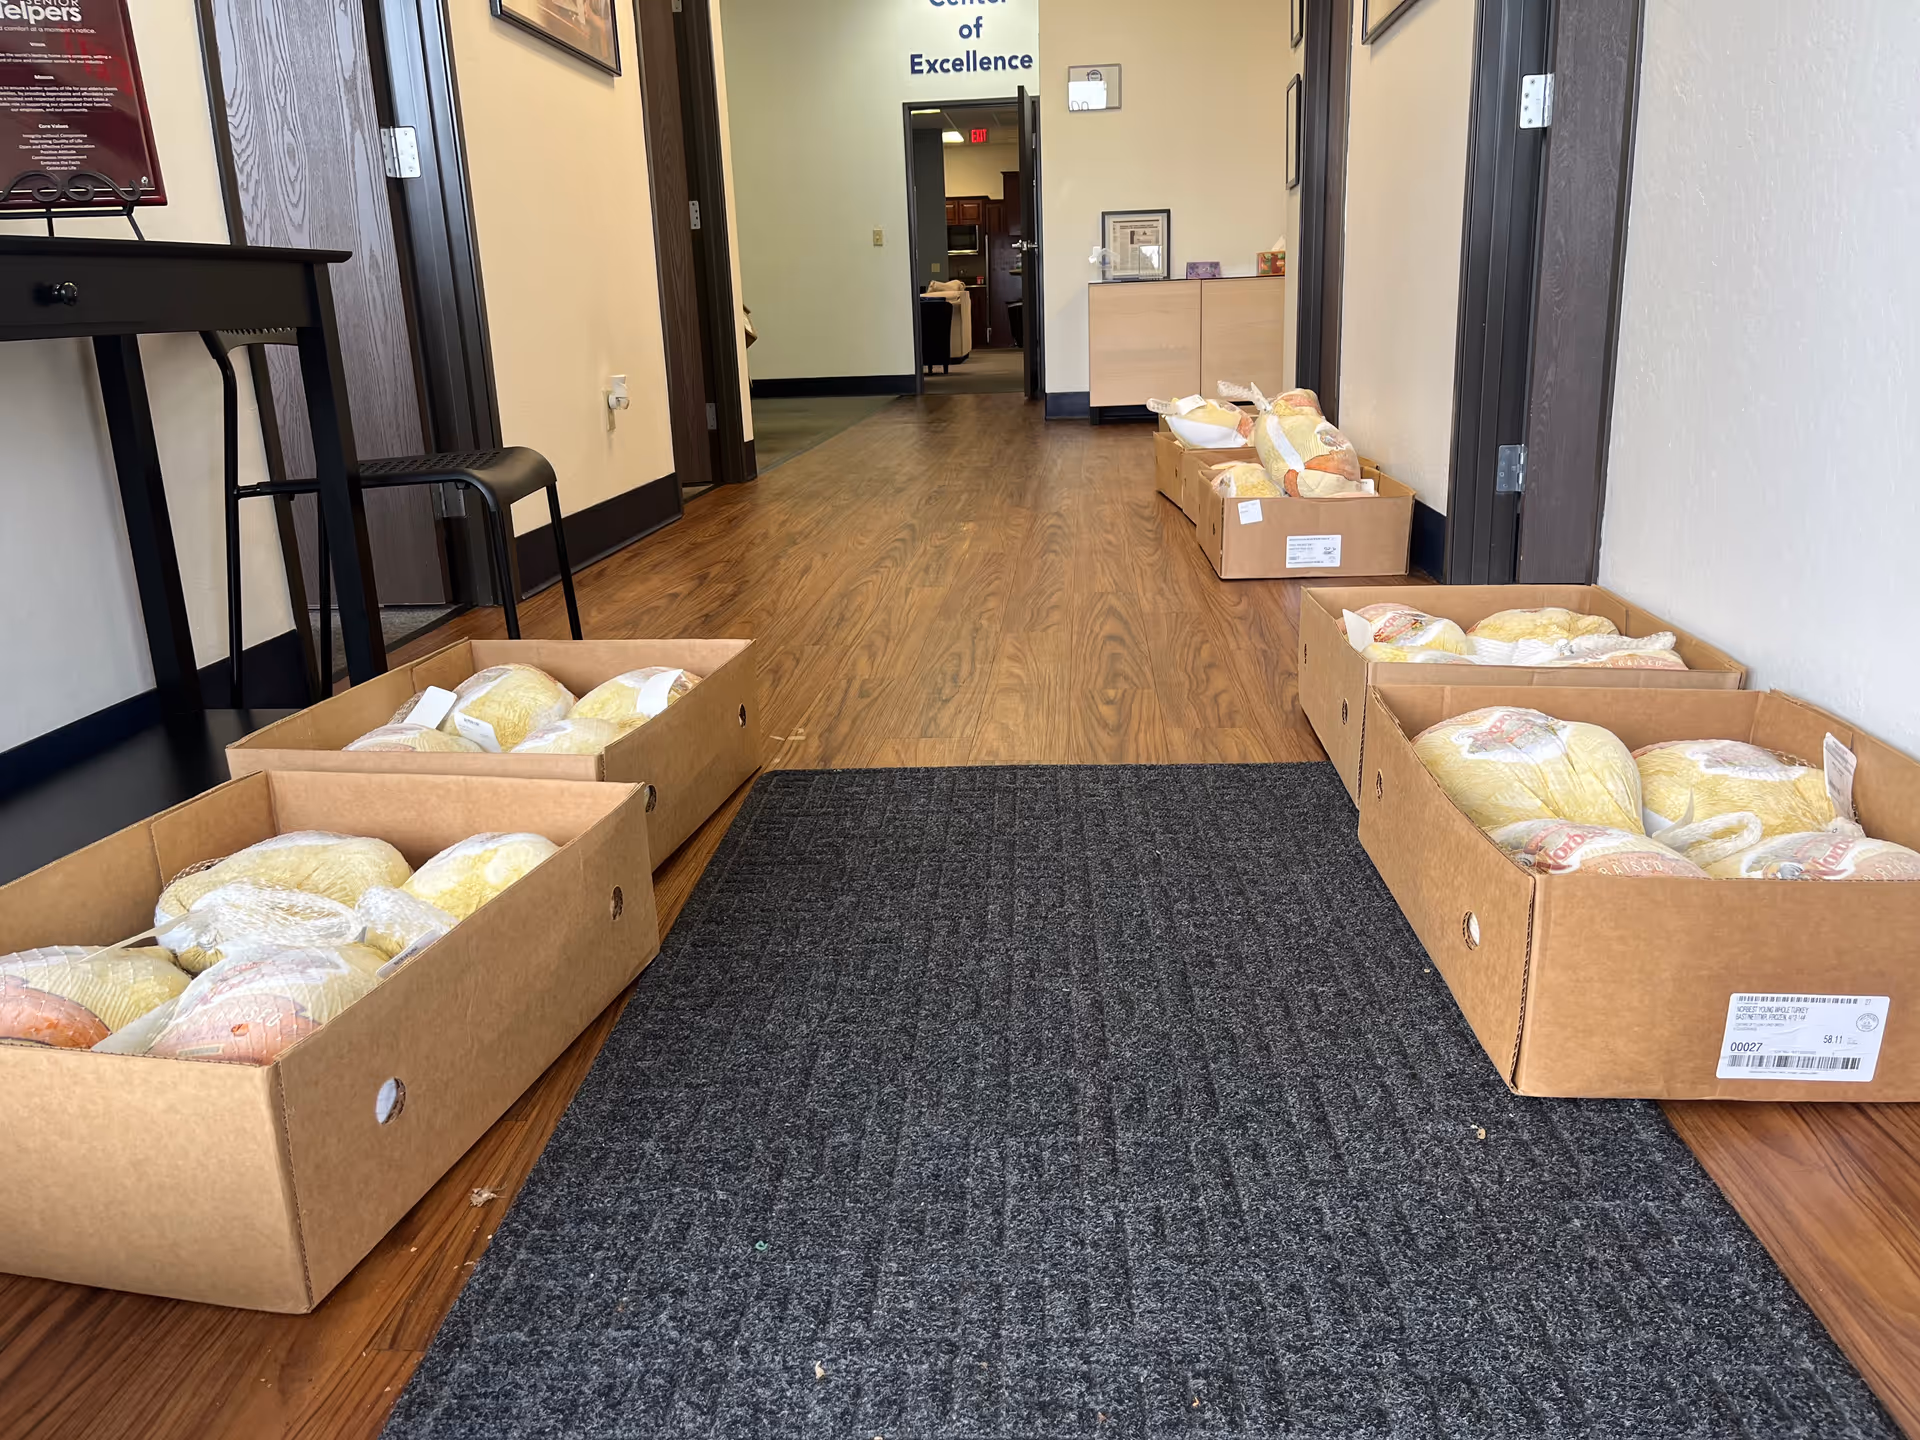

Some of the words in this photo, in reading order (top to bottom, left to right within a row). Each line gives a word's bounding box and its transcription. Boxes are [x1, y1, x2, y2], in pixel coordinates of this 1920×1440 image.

[959, 16, 983, 39] of
[910, 50, 1033, 75] Excellence
[971, 129, 987, 143] EXIT
[1598, 859, 1664, 877] RAISED
[1730, 1042, 1764, 1053] 00027
[1823, 1034, 1844, 1045] 58.11
